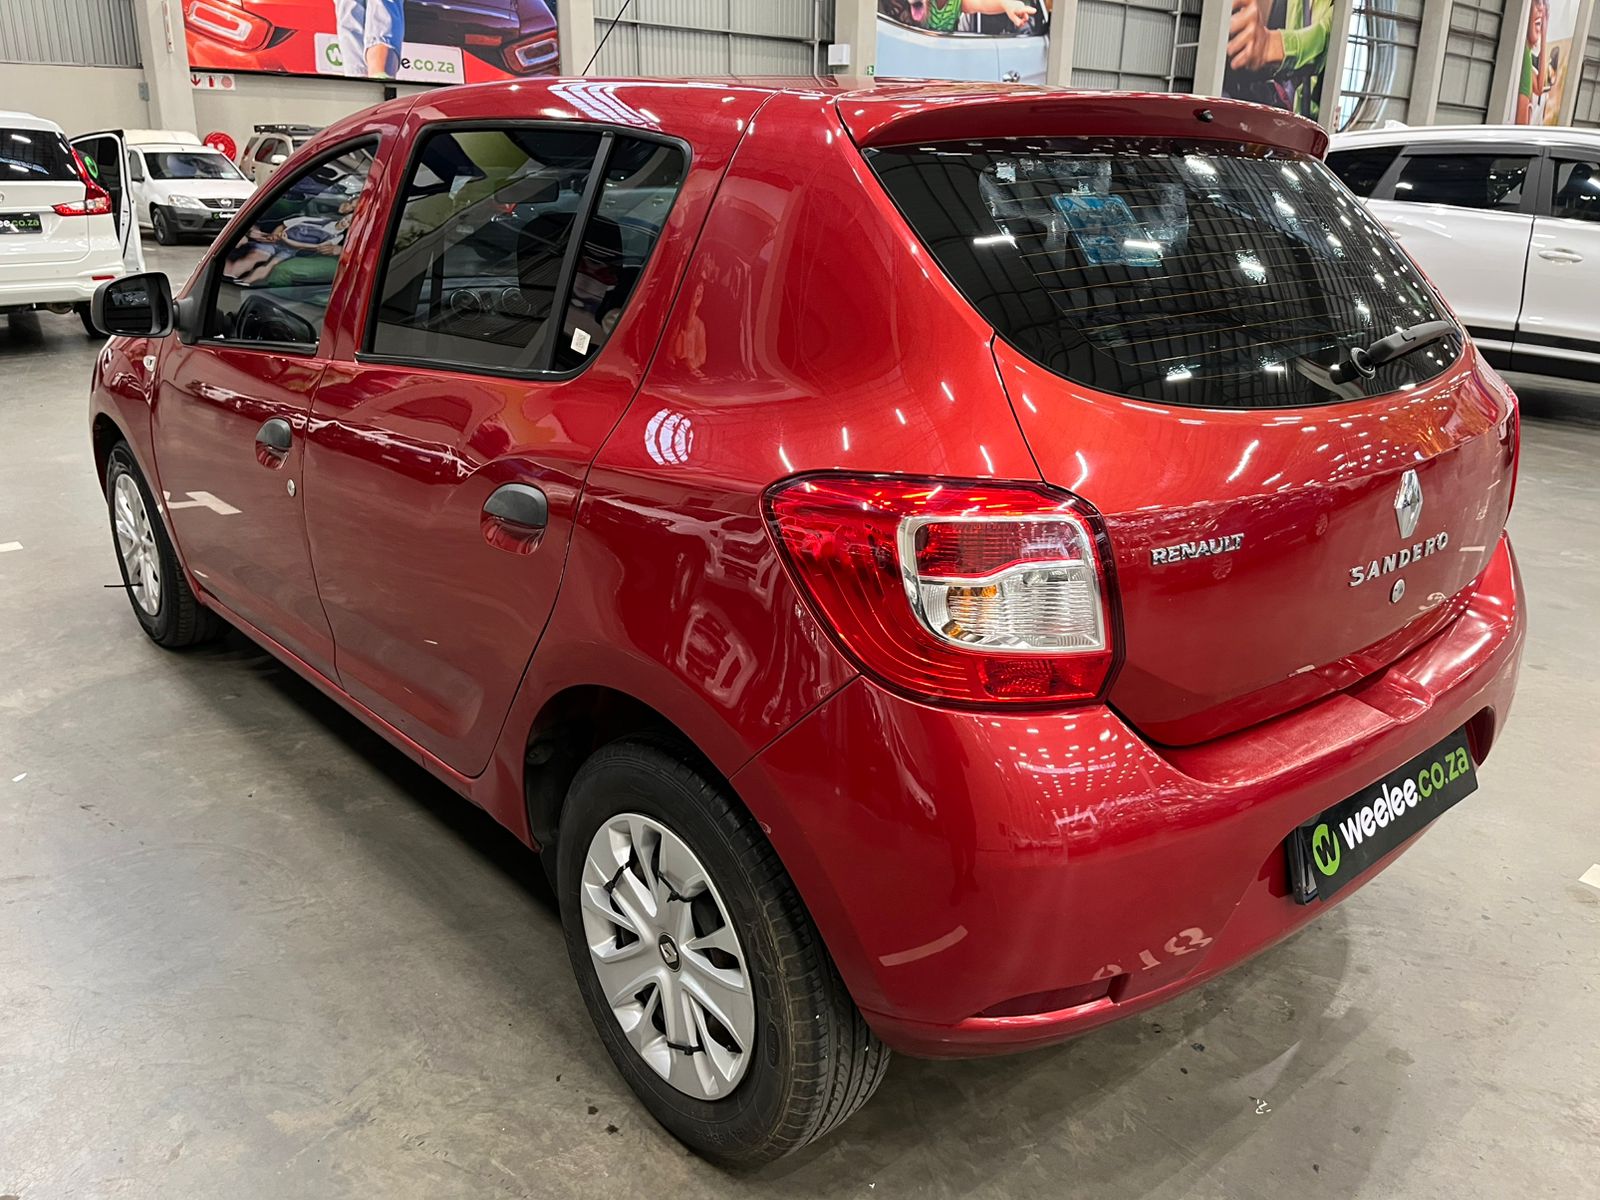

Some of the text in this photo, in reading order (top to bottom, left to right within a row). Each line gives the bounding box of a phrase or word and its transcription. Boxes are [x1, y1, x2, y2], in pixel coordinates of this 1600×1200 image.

[1151, 533, 1245, 565] RENAULT
[1348, 531, 1449, 587] SANDERO
[1339, 746, 1470, 850] weelee.co.za
